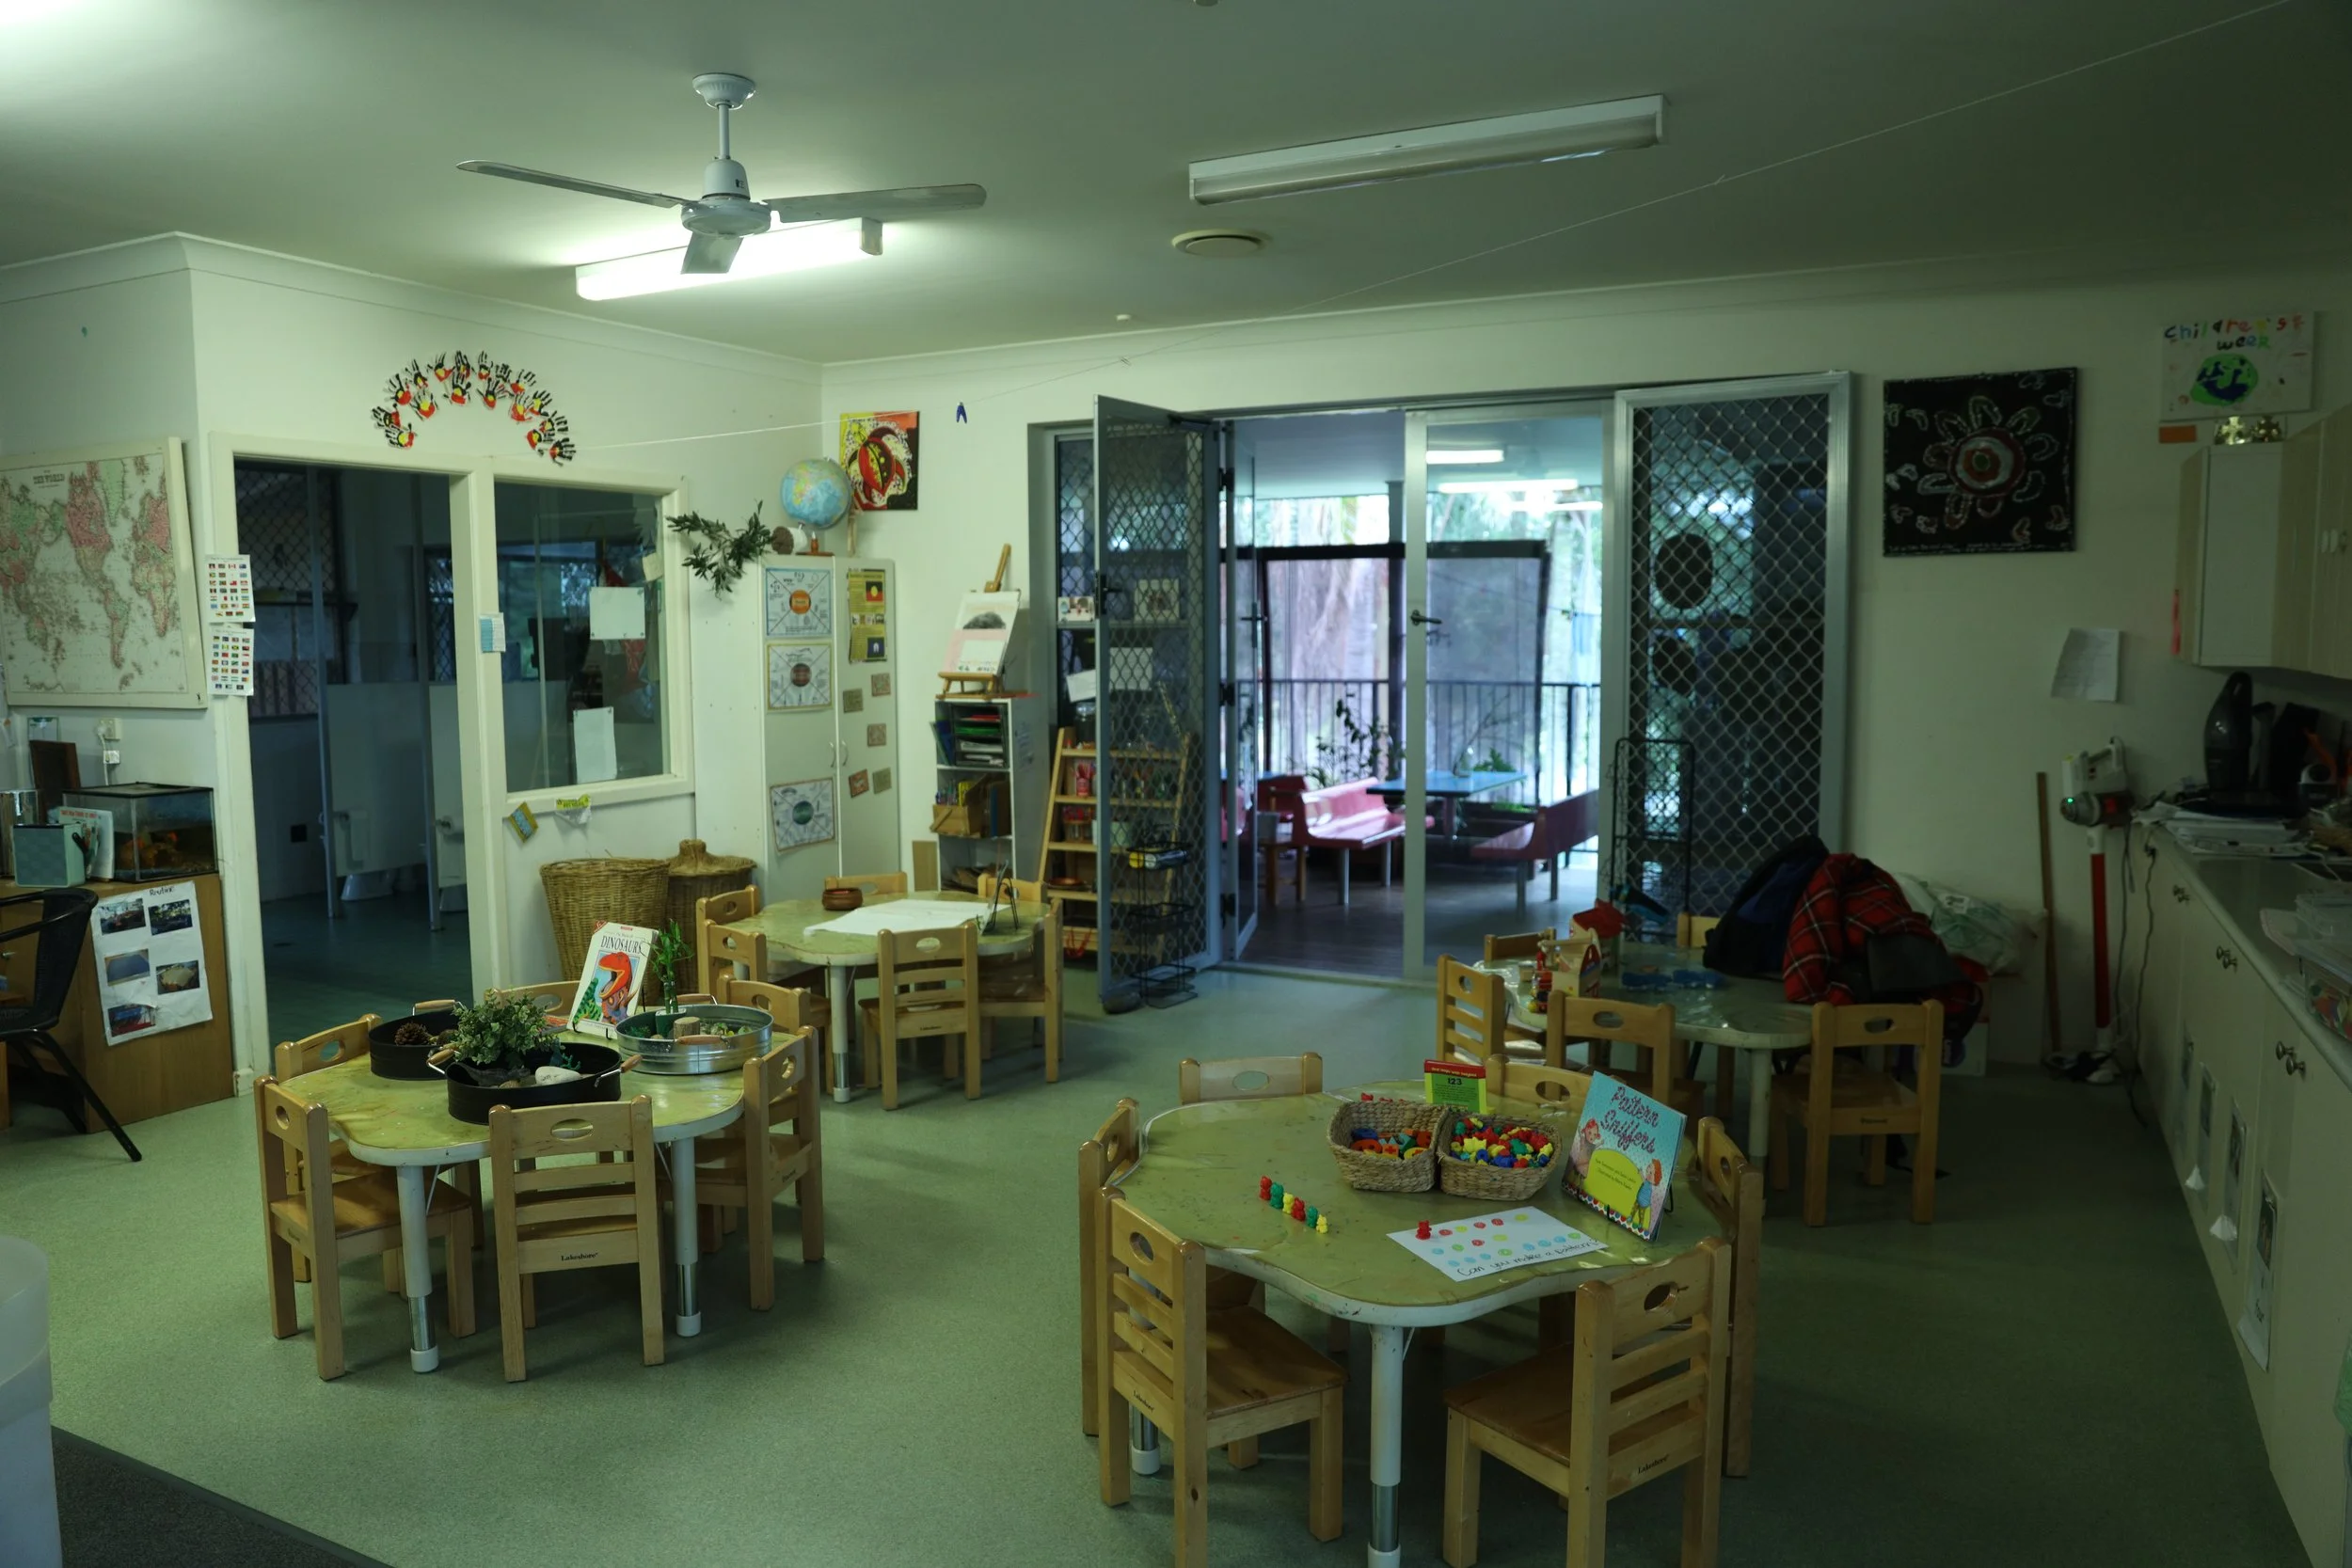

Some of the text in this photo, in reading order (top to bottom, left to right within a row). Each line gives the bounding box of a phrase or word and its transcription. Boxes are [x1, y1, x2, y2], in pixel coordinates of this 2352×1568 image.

[600, 935, 642, 955] DINOSAURS
[1447, 1077, 1463, 1085] 123
[1610, 1086, 1660, 1129] Pattern
[1599, 1110, 1656, 1153] Sniffers
